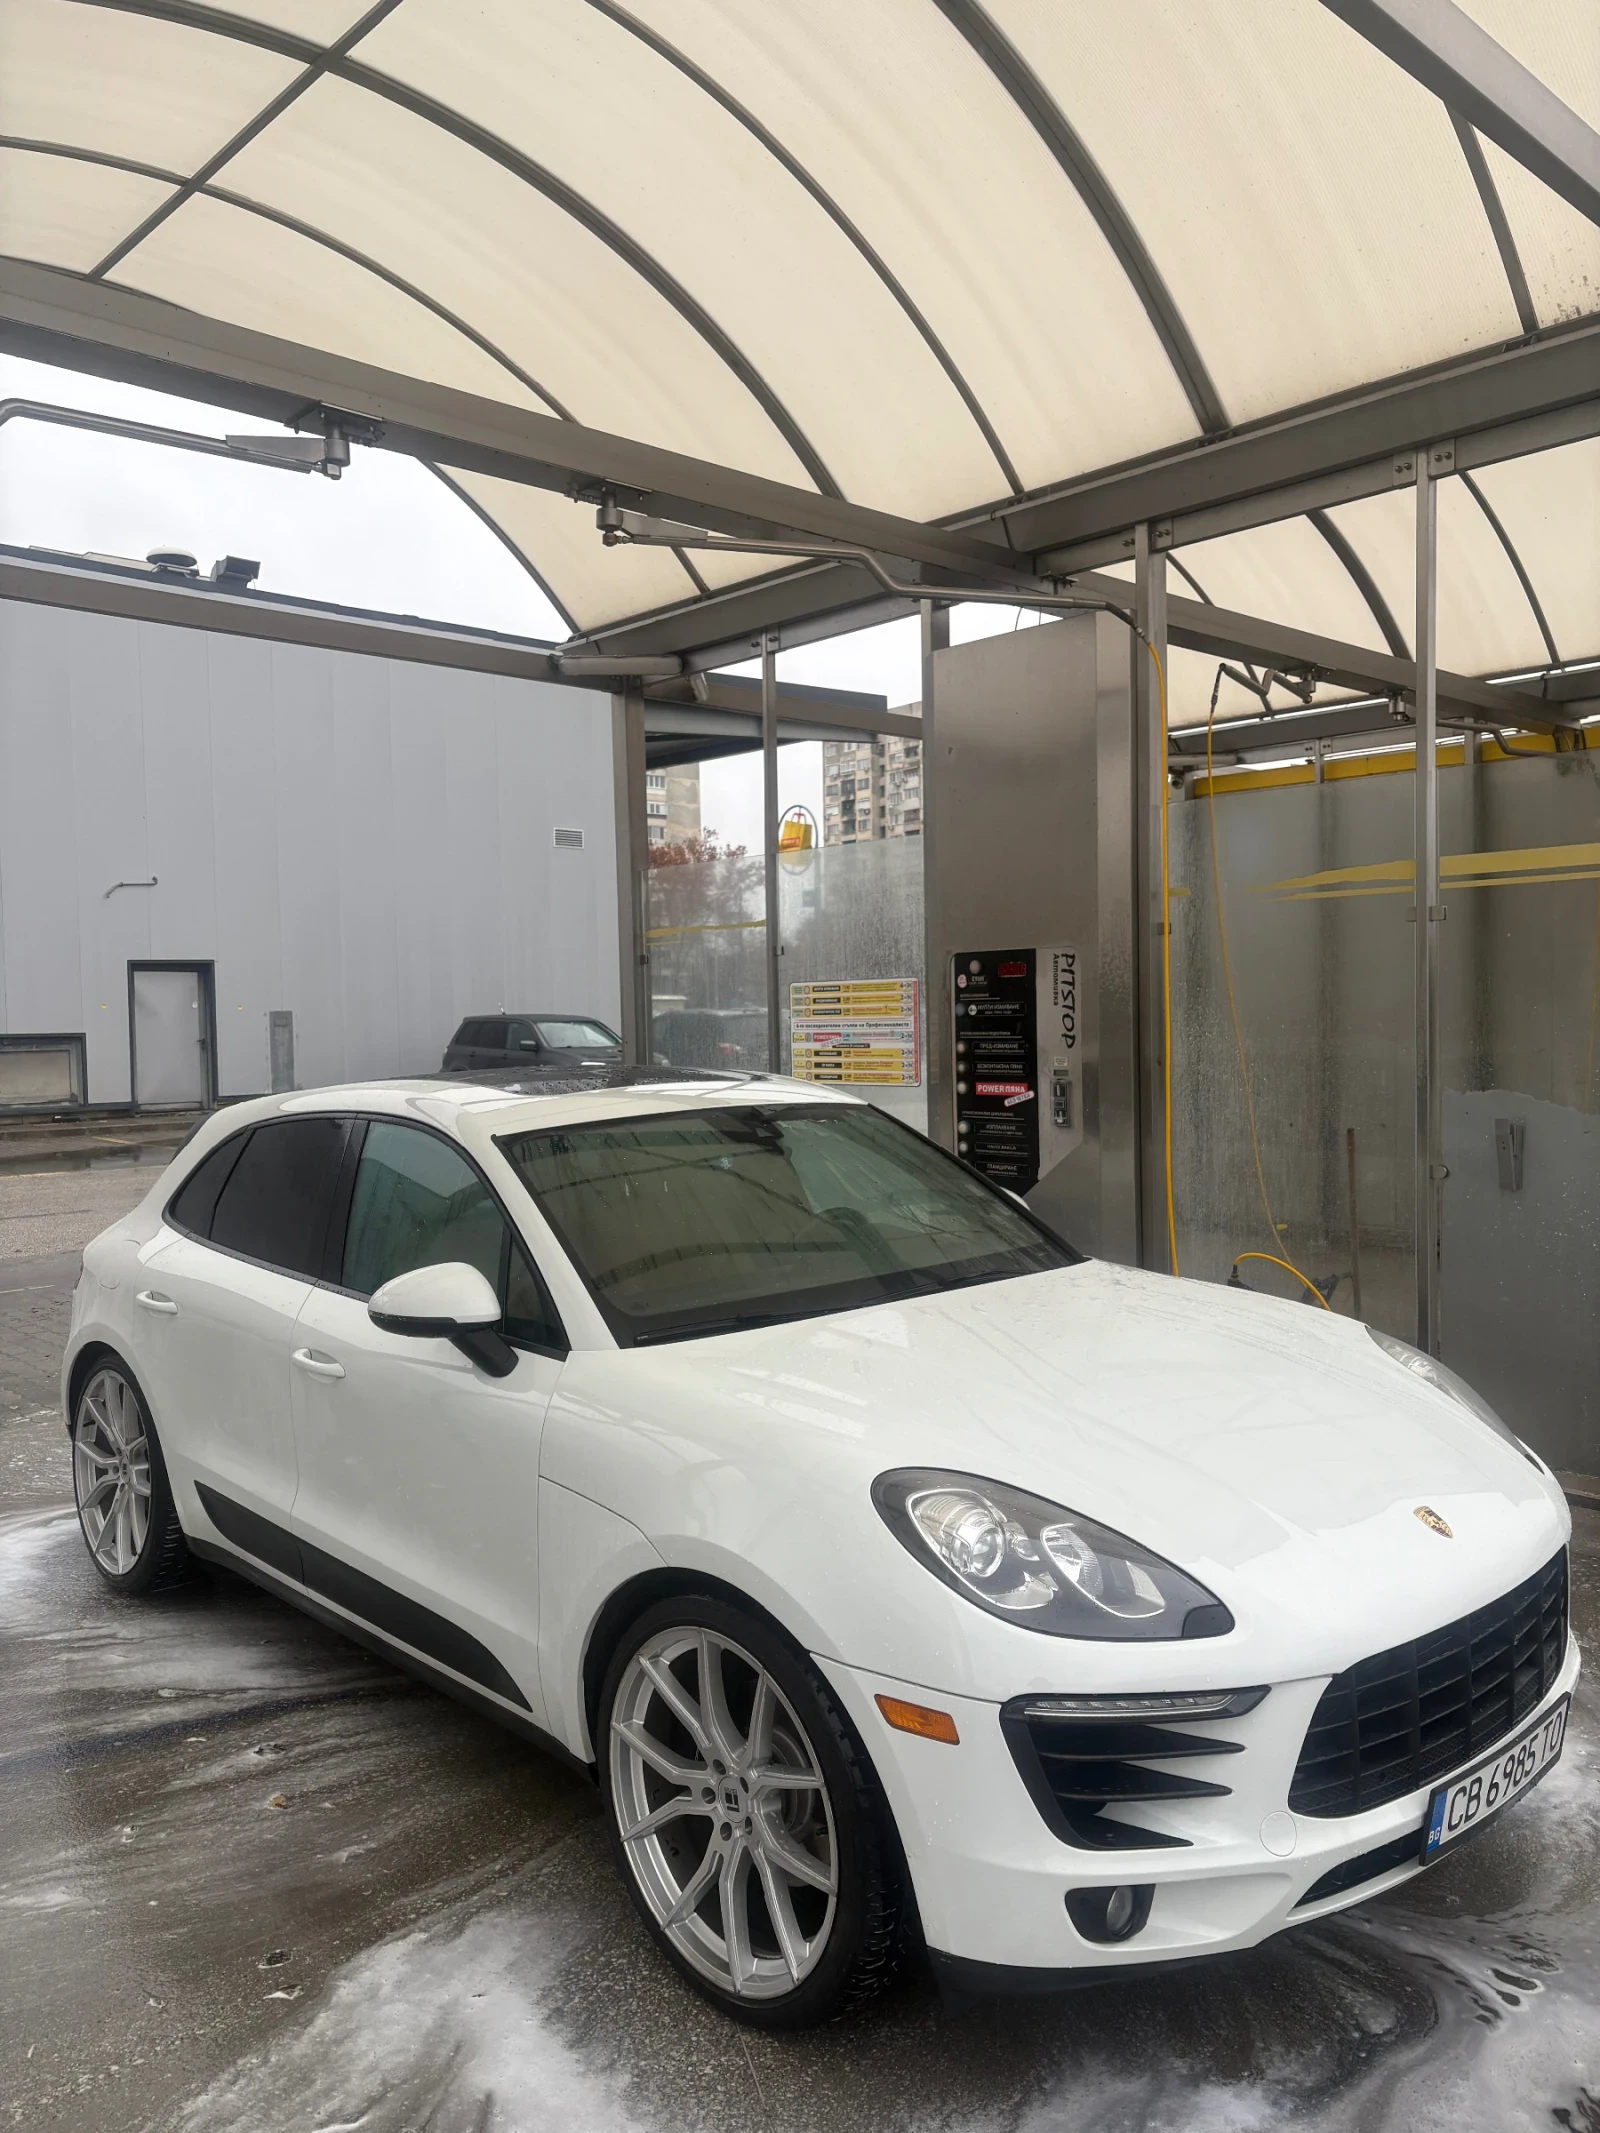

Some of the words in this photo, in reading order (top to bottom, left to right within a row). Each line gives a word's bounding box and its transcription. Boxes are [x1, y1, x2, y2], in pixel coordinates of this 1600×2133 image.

[1061, 953, 1076, 1049] PITSTOP
[1447, 1776, 1483, 1832] CB
[1486, 1733, 1539, 1808] 6985
[1541, 1710, 1563, 1762] TO
[1427, 1828, 1442, 1844] BG
